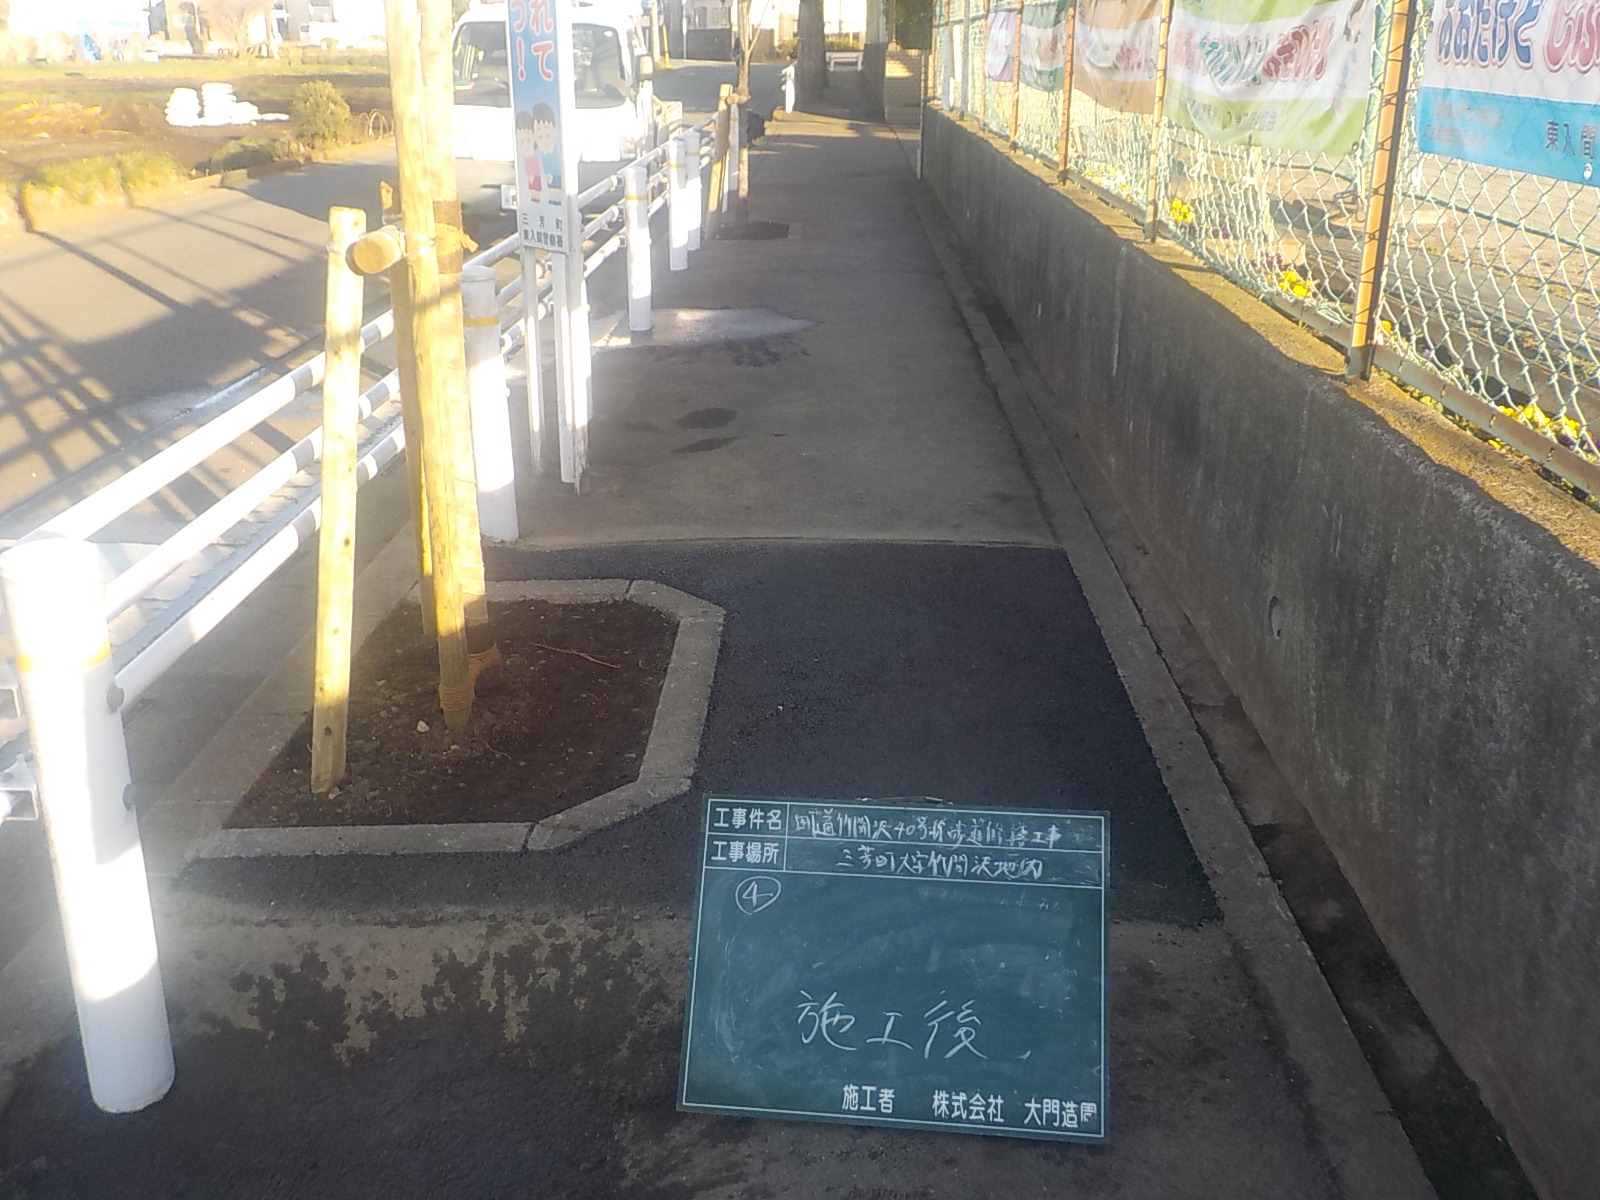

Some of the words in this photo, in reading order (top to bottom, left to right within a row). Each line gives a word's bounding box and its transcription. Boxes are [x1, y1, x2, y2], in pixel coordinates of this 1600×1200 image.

[713, 806, 783, 832] 工事件名
[710, 840, 781, 865] 工事場所
[797, 990, 989, 1060] 施工後
[841, 1084, 896, 1114] 施工者
[932, 1090, 1005, 1124] 株式会社
